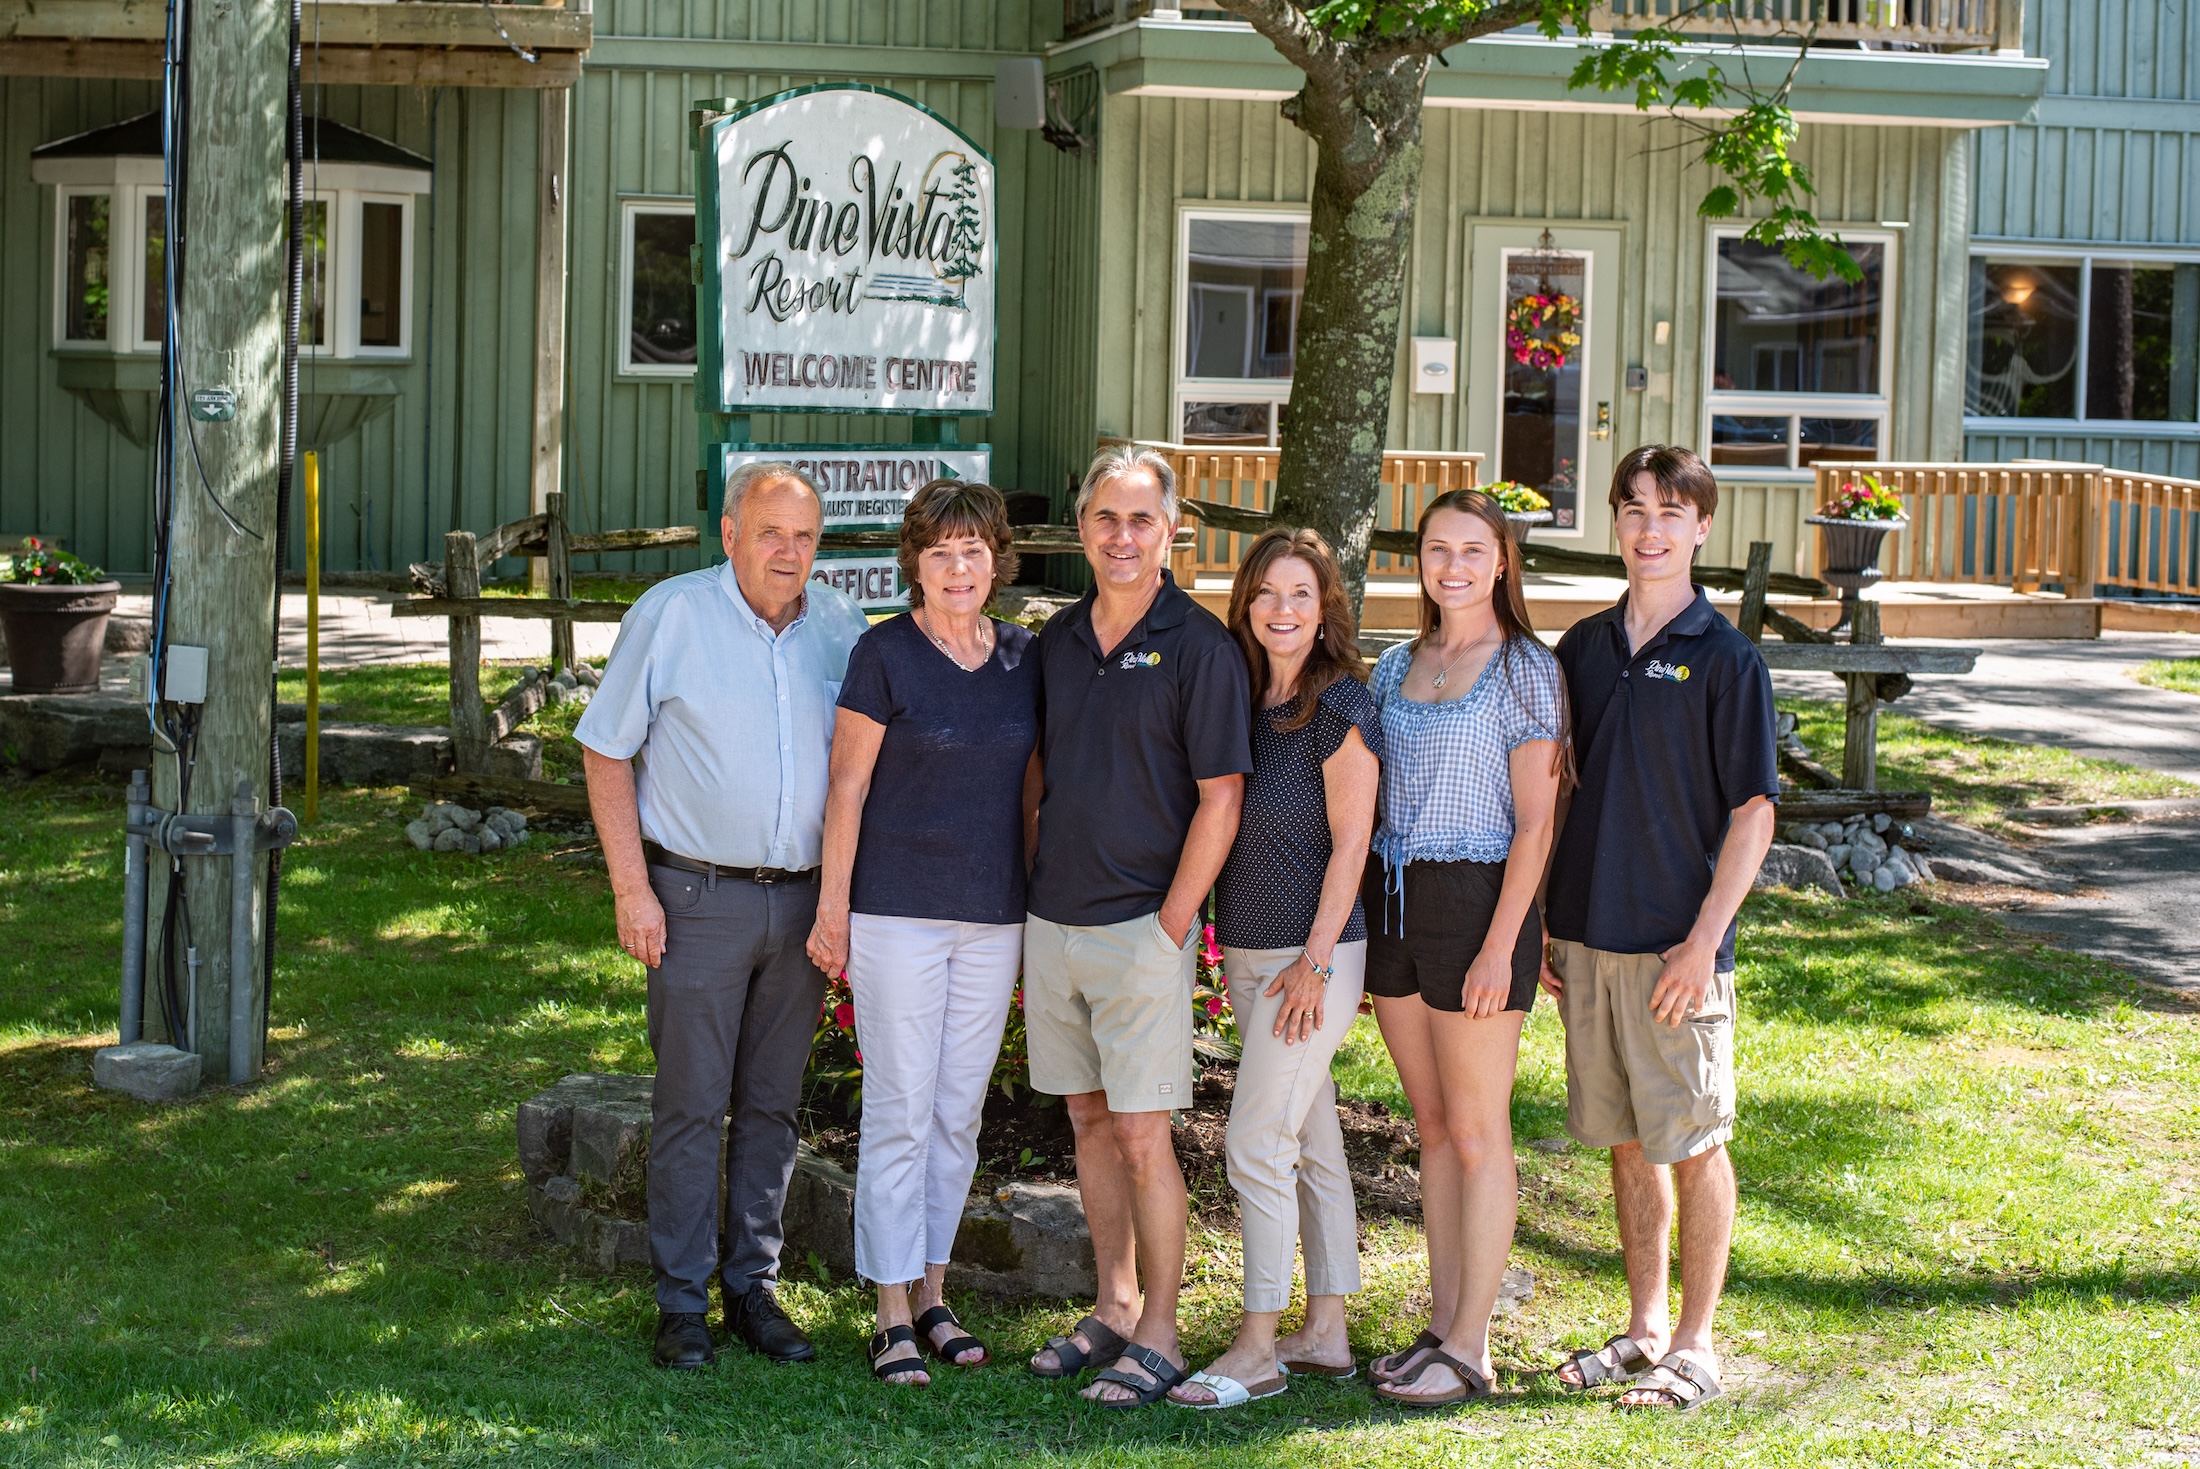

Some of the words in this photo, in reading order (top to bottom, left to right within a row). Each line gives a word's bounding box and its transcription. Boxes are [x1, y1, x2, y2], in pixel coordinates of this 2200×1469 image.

[728, 140, 859, 260] Pine
[850, 154, 961, 264] Vista
[743, 250, 863, 322] Resort
[742, 351, 877, 390] WELCOME
[885, 356, 978, 393] CENTRE
[768, 459, 935, 493] ISTRATION
[855, 498, 911, 516] REGISTE
